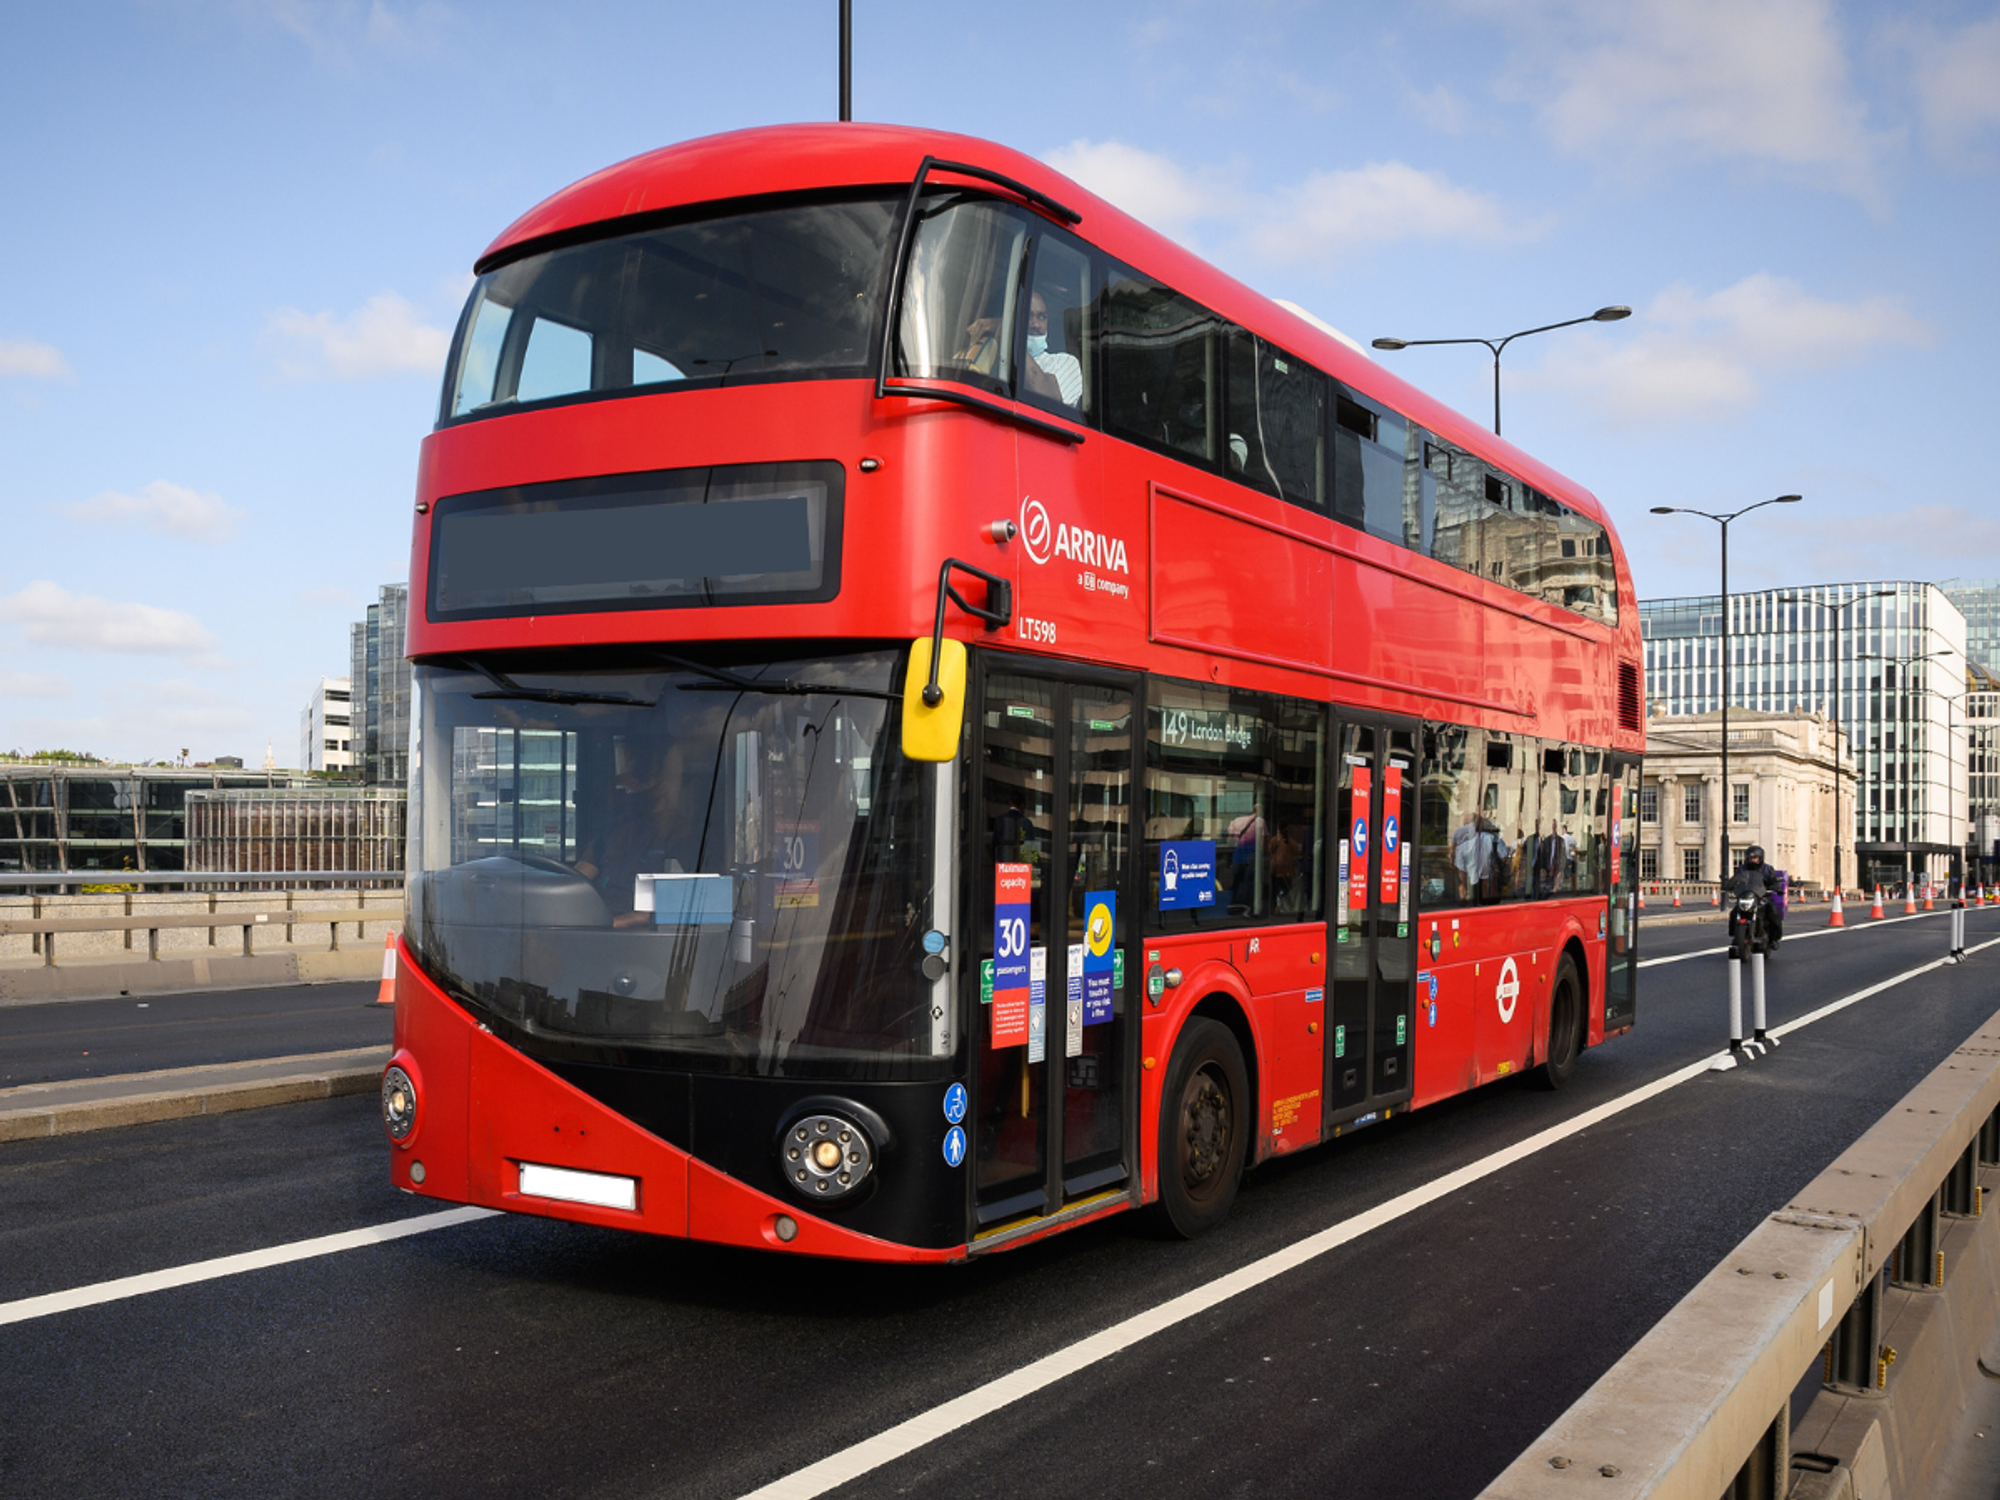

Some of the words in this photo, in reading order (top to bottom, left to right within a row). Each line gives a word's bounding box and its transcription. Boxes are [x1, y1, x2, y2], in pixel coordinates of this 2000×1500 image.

[1054, 523, 1129, 575] ARRIVA
[1077, 573, 1083, 585] a
[1096, 578, 1129, 600] company
[1020, 616, 1056, 644] LT598
[1162, 711, 1188, 745] 149
[1191, 720, 1223, 741] London
[1225, 724, 1251, 750] Bridge
[783, 836, 805, 870] 30
[998, 863, 1029, 873] Maximum
[1000, 877, 1026, 889] capacity
[998, 917, 1026, 958] 30
[996, 965, 1027, 977] passengers
